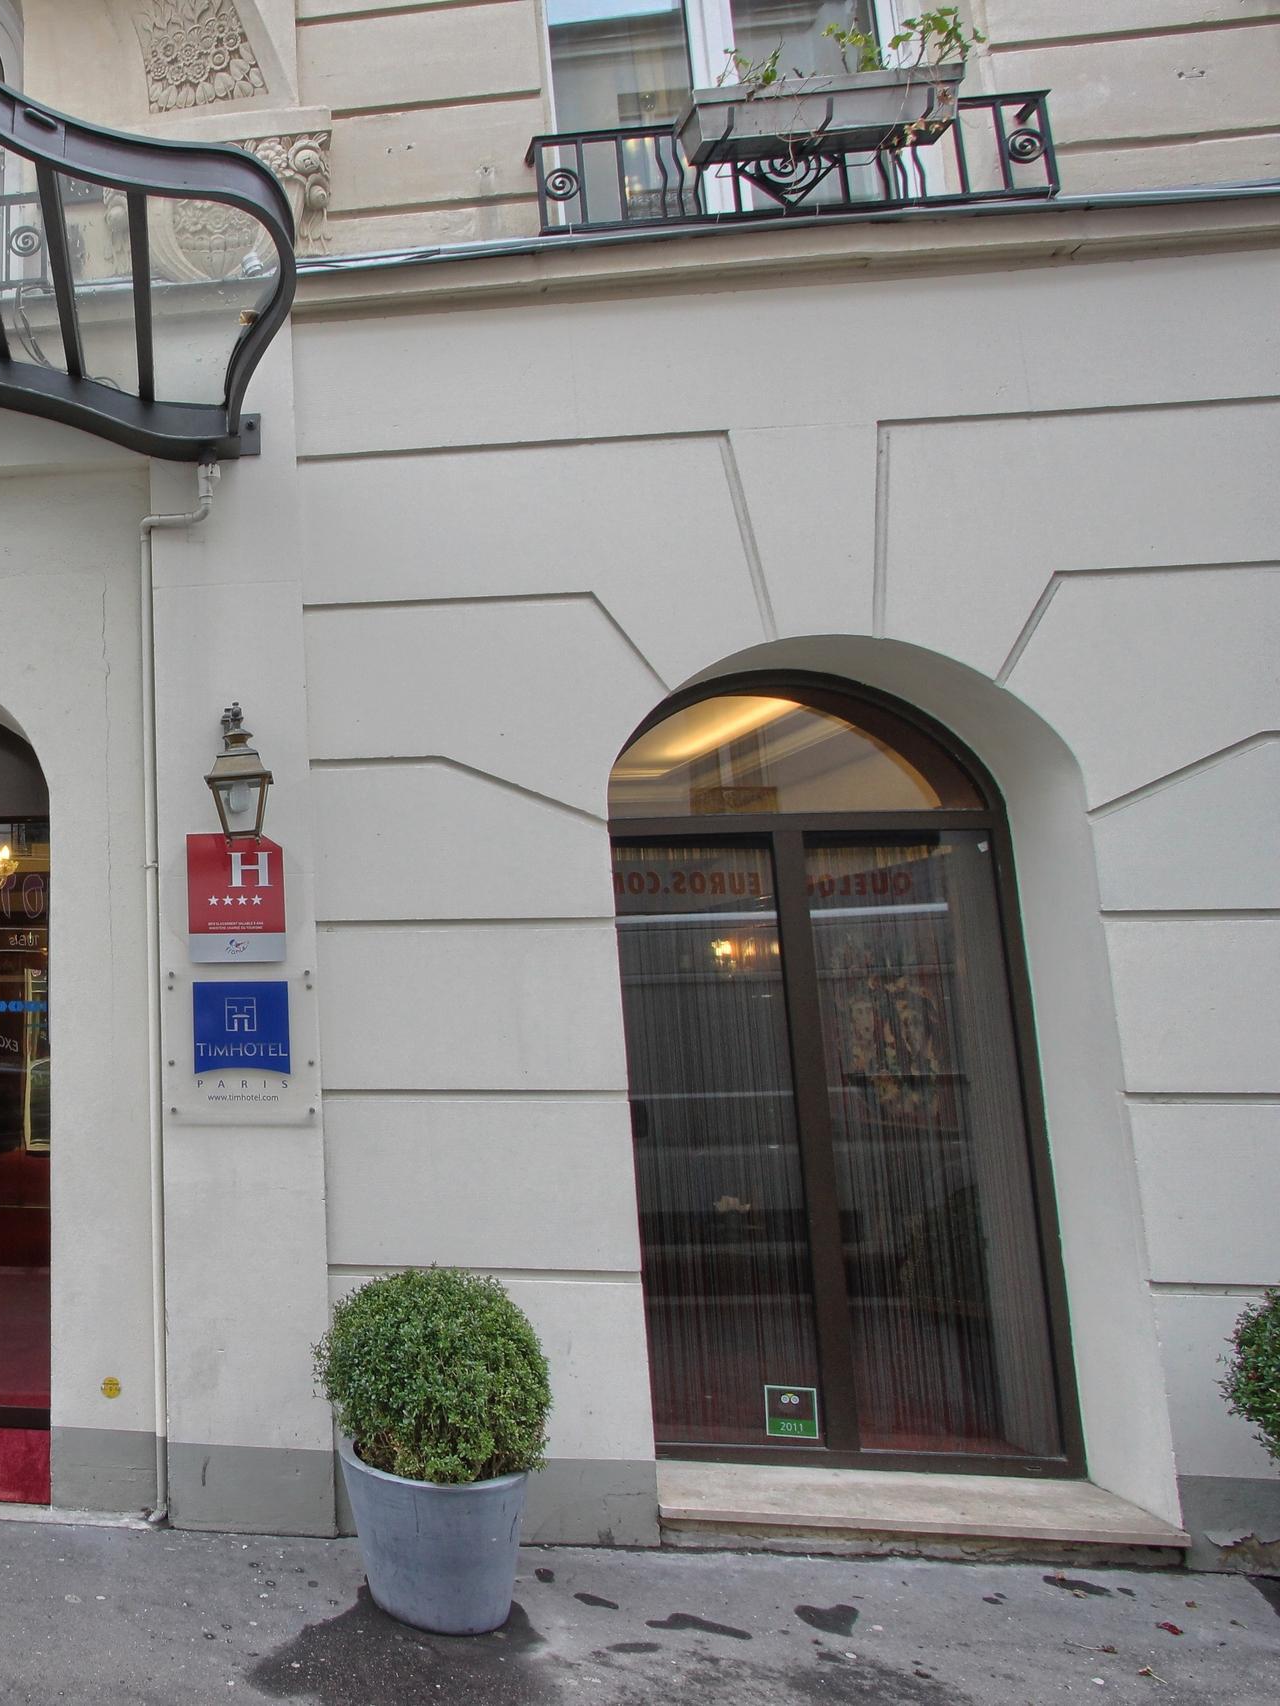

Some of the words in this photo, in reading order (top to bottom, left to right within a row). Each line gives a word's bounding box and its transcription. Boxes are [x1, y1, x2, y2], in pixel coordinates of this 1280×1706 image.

[227, 851, 273, 888] H
[196, 1042, 289, 1057] TIMHOTEL
[207, 1093, 279, 1102] www.timhotel.com
[780, 1421, 804, 1432] 2011
